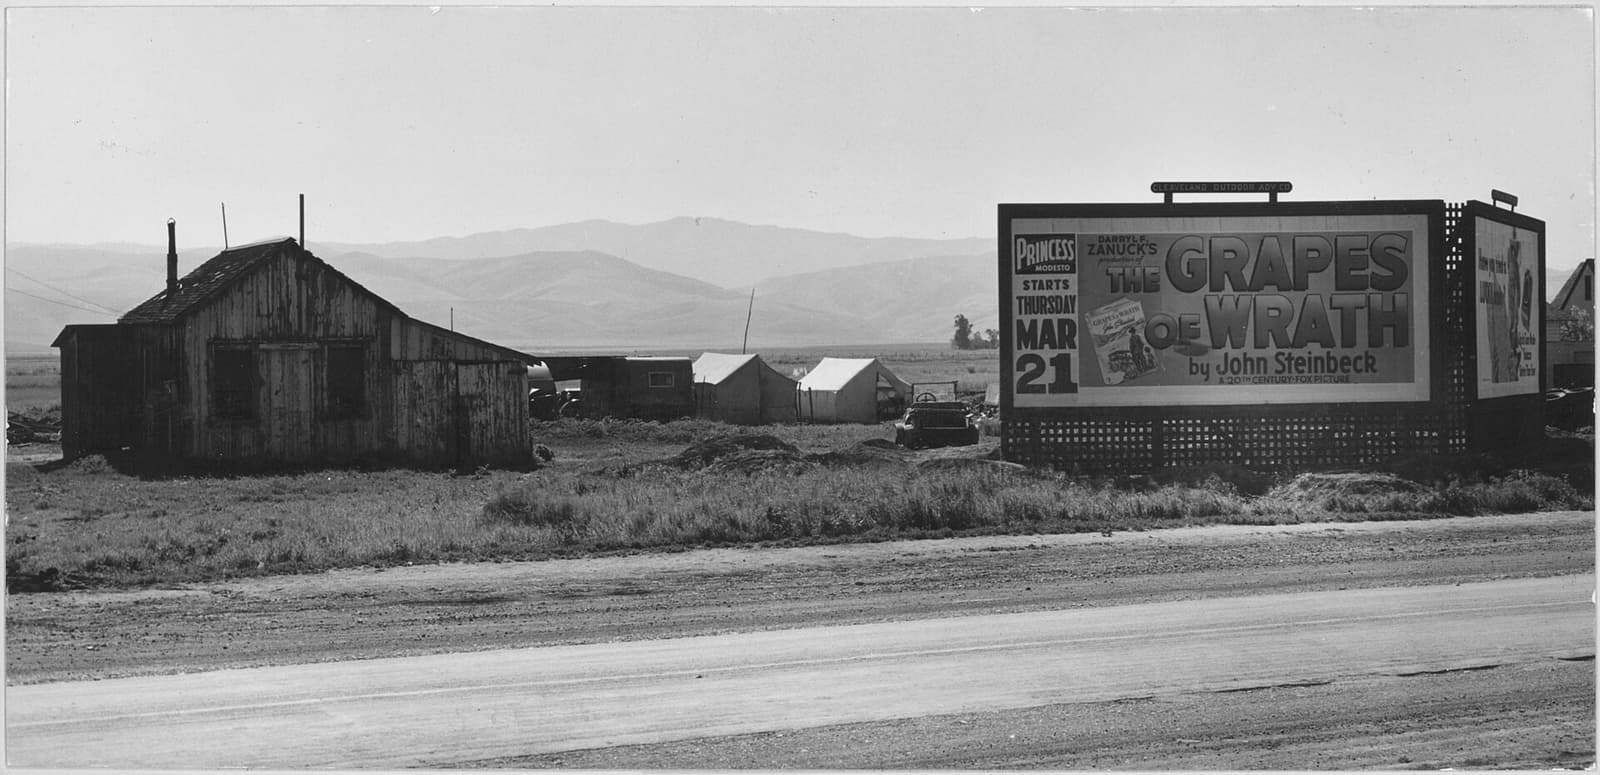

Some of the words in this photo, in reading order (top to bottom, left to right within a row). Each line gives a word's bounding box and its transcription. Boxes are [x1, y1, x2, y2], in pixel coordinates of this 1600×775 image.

[1213, 183, 1255, 192] OUTDOOR
[1016, 237, 1075, 270] PRINCESS
[1088, 244, 1158, 256] ZANUCK'S
[1035, 264, 1070, 272] MODESTO
[1106, 266, 1160, 294] THE
[1165, 233, 1408, 293] GRAPES
[1023, 279, 1070, 291] STARTS
[1016, 295, 1076, 315] THURSDAY
[1144, 313, 1201, 350] OF
[1204, 292, 1409, 349] WRATH
[1016, 318, 1077, 350] MAR
[1015, 353, 1079, 394] 21
[1188, 358, 1210, 382] by
[1216, 353, 1268, 376] John
[1274, 352, 1378, 374] Steinbeck
[1314, 375, 1350, 384] PICTURE
